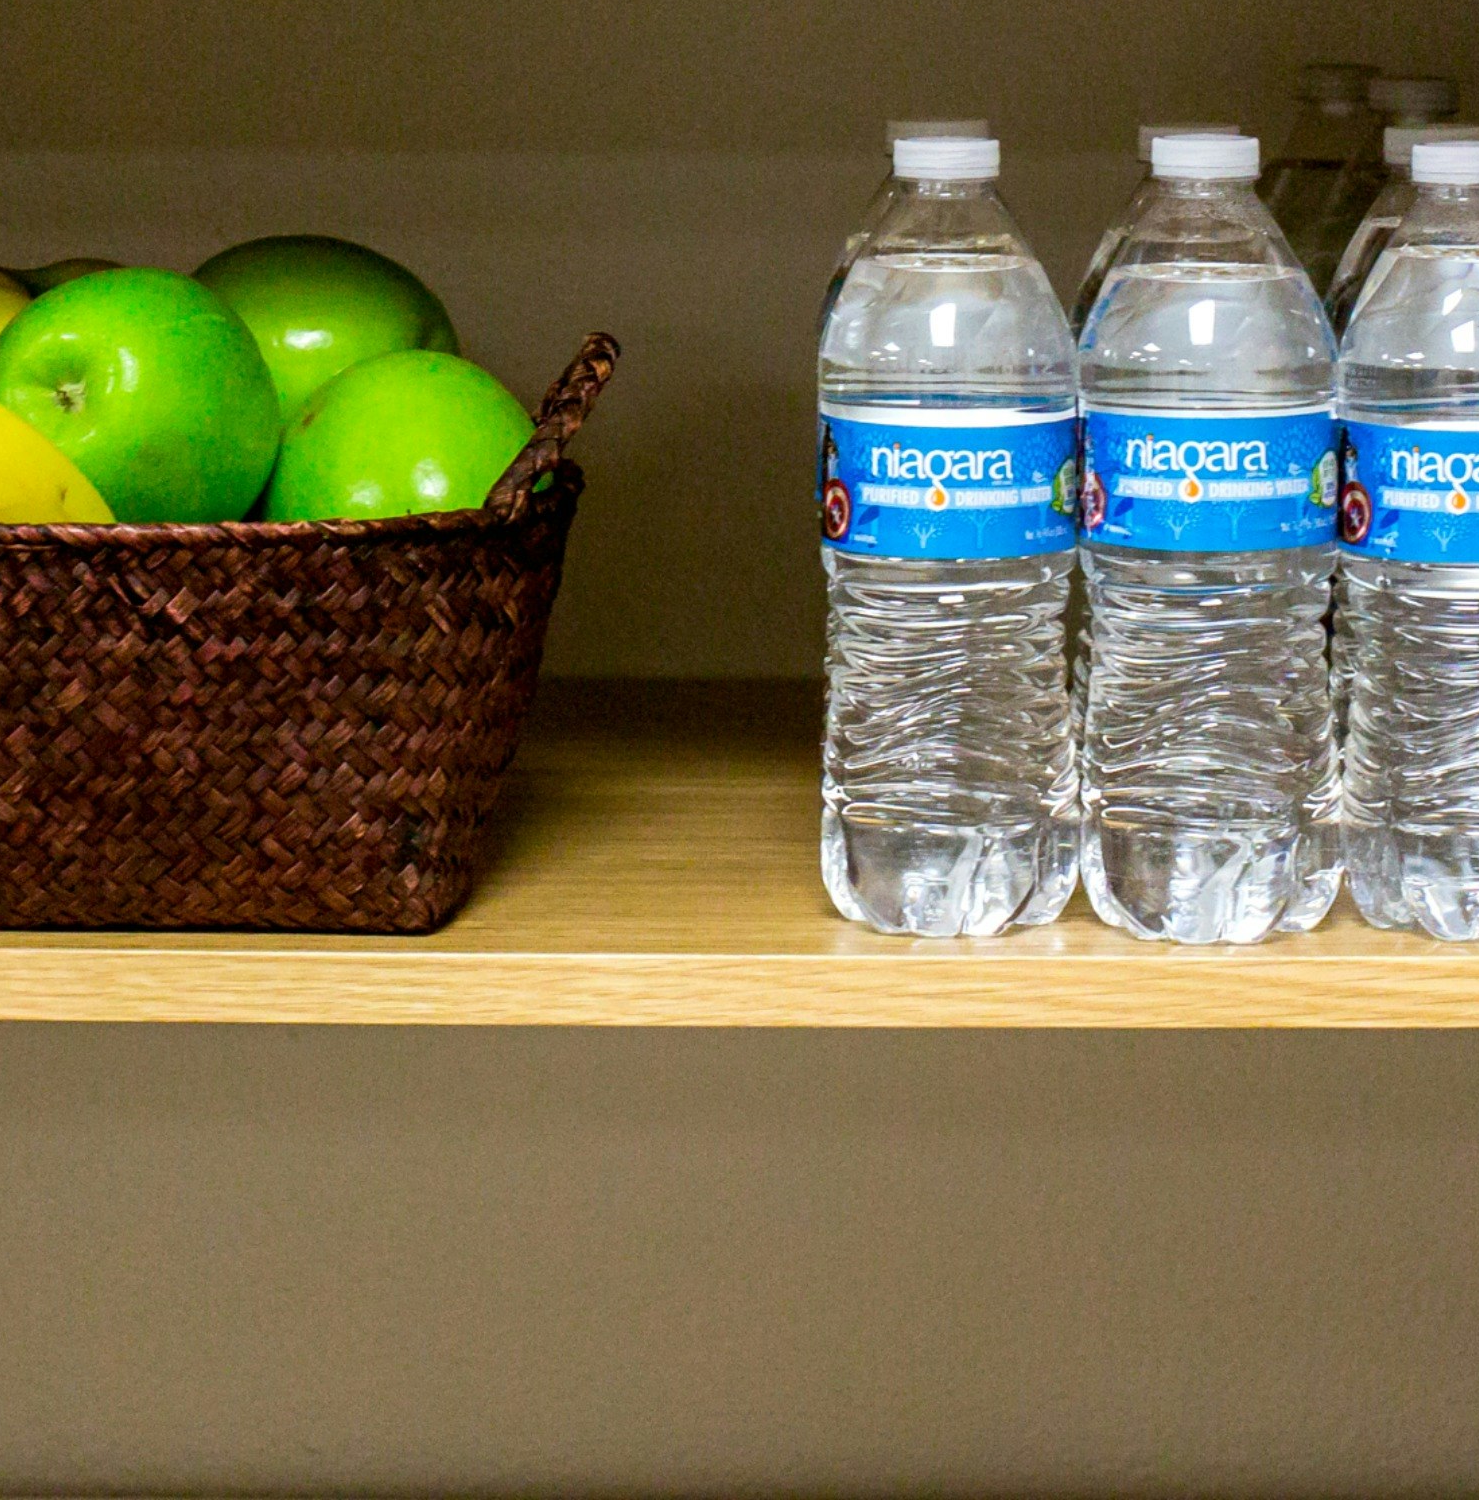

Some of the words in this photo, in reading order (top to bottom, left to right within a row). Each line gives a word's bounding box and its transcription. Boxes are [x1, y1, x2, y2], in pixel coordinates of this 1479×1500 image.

[872, 442, 1014, 511] niagara
[1125, 433, 1269, 503] niagara
[862, 486, 920, 506] PURIFIED
[955, 487, 1019, 507] DRINKING
[1208, 480, 1273, 498] DRINKING
[1383, 490, 1440, 509] PURIFIED
